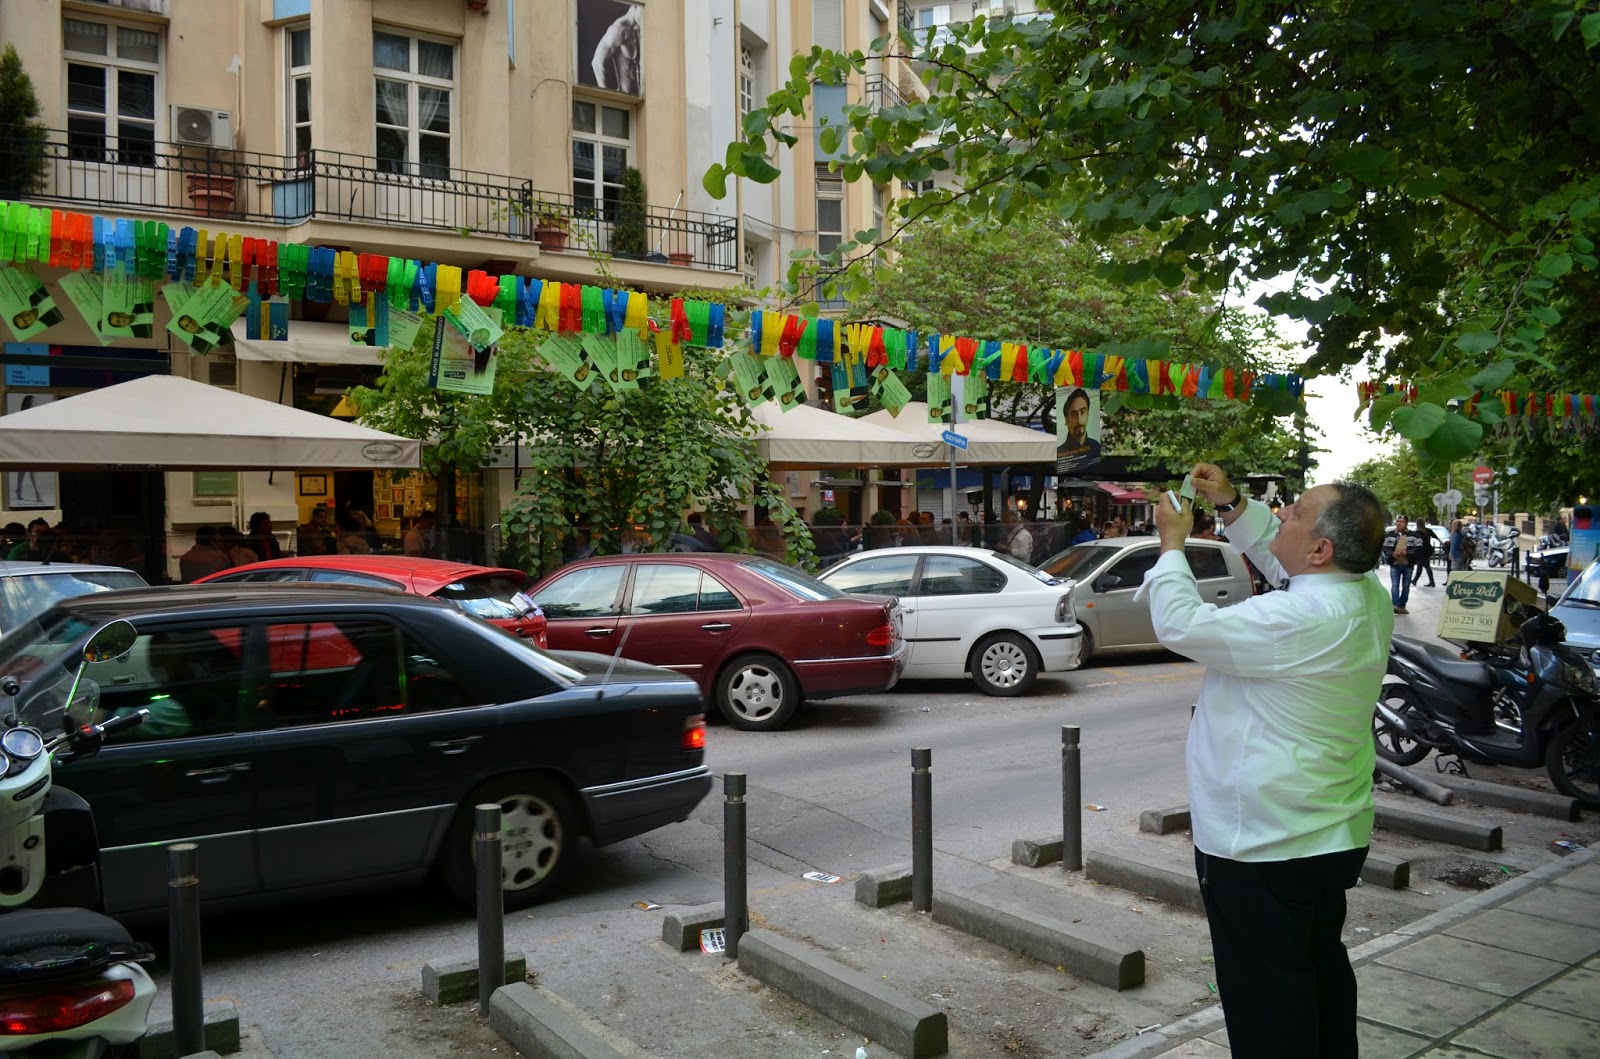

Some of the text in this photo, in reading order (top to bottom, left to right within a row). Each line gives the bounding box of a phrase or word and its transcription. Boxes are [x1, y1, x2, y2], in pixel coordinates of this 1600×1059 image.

[1452, 585, 1498, 598] Very Deli
[1444, 616, 1493, 626] 2310 221 300
[7, 933, 69, 946] PIAGGIO
